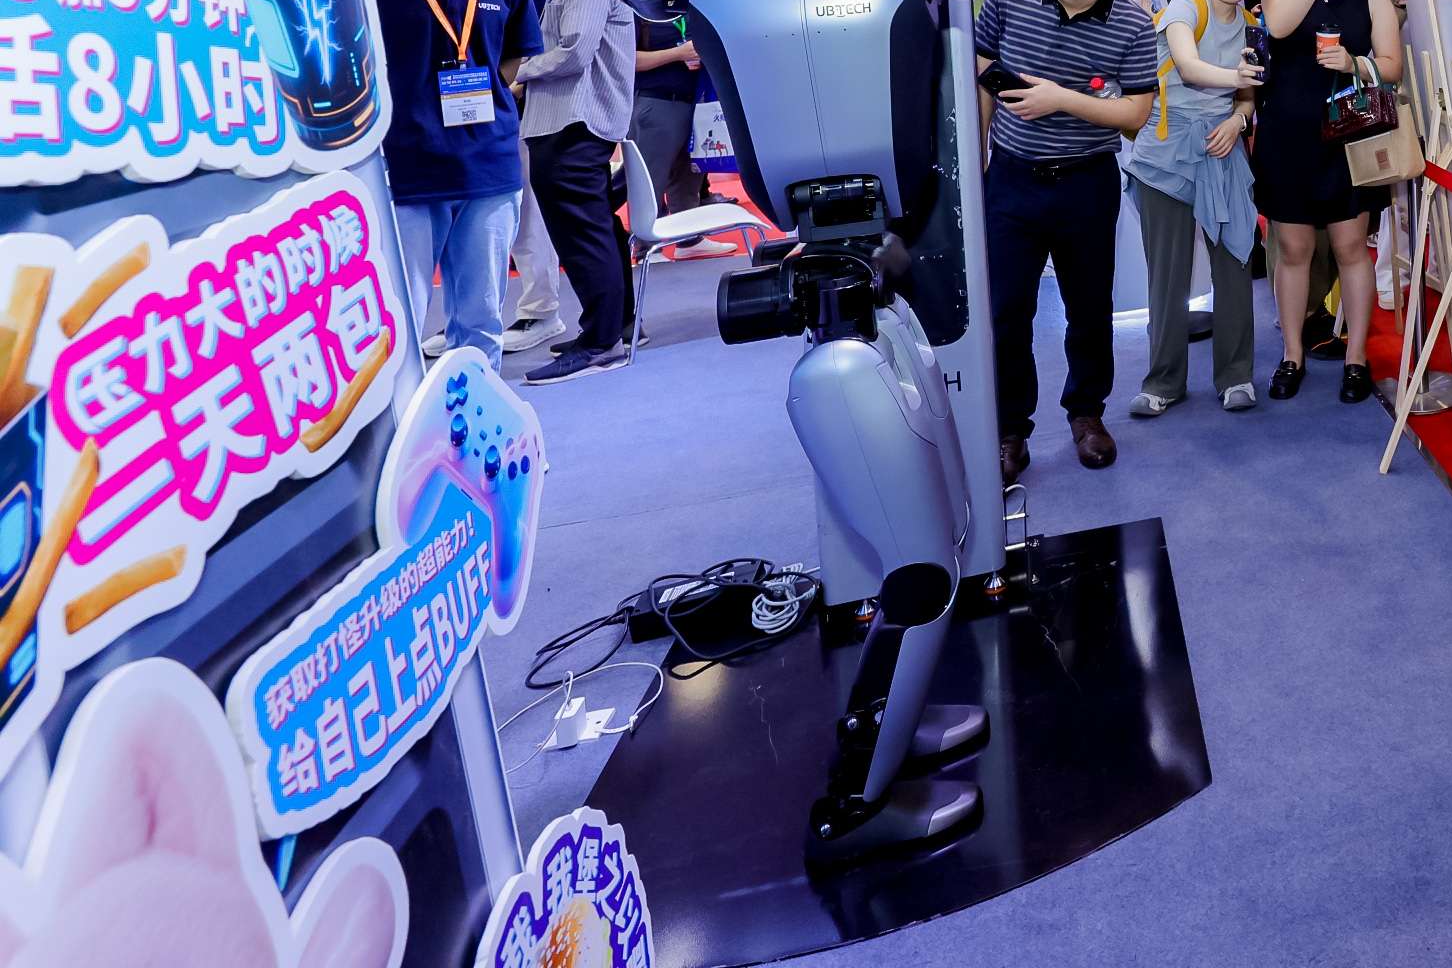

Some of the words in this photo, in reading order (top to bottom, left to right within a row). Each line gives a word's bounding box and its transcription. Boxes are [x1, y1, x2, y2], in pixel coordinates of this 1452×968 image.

[815, 2, 872, 18] UBTECH
[66, 206, 365, 434] 压力大的时候
[278, 541, 492, 797] 给自己上点BUFF
